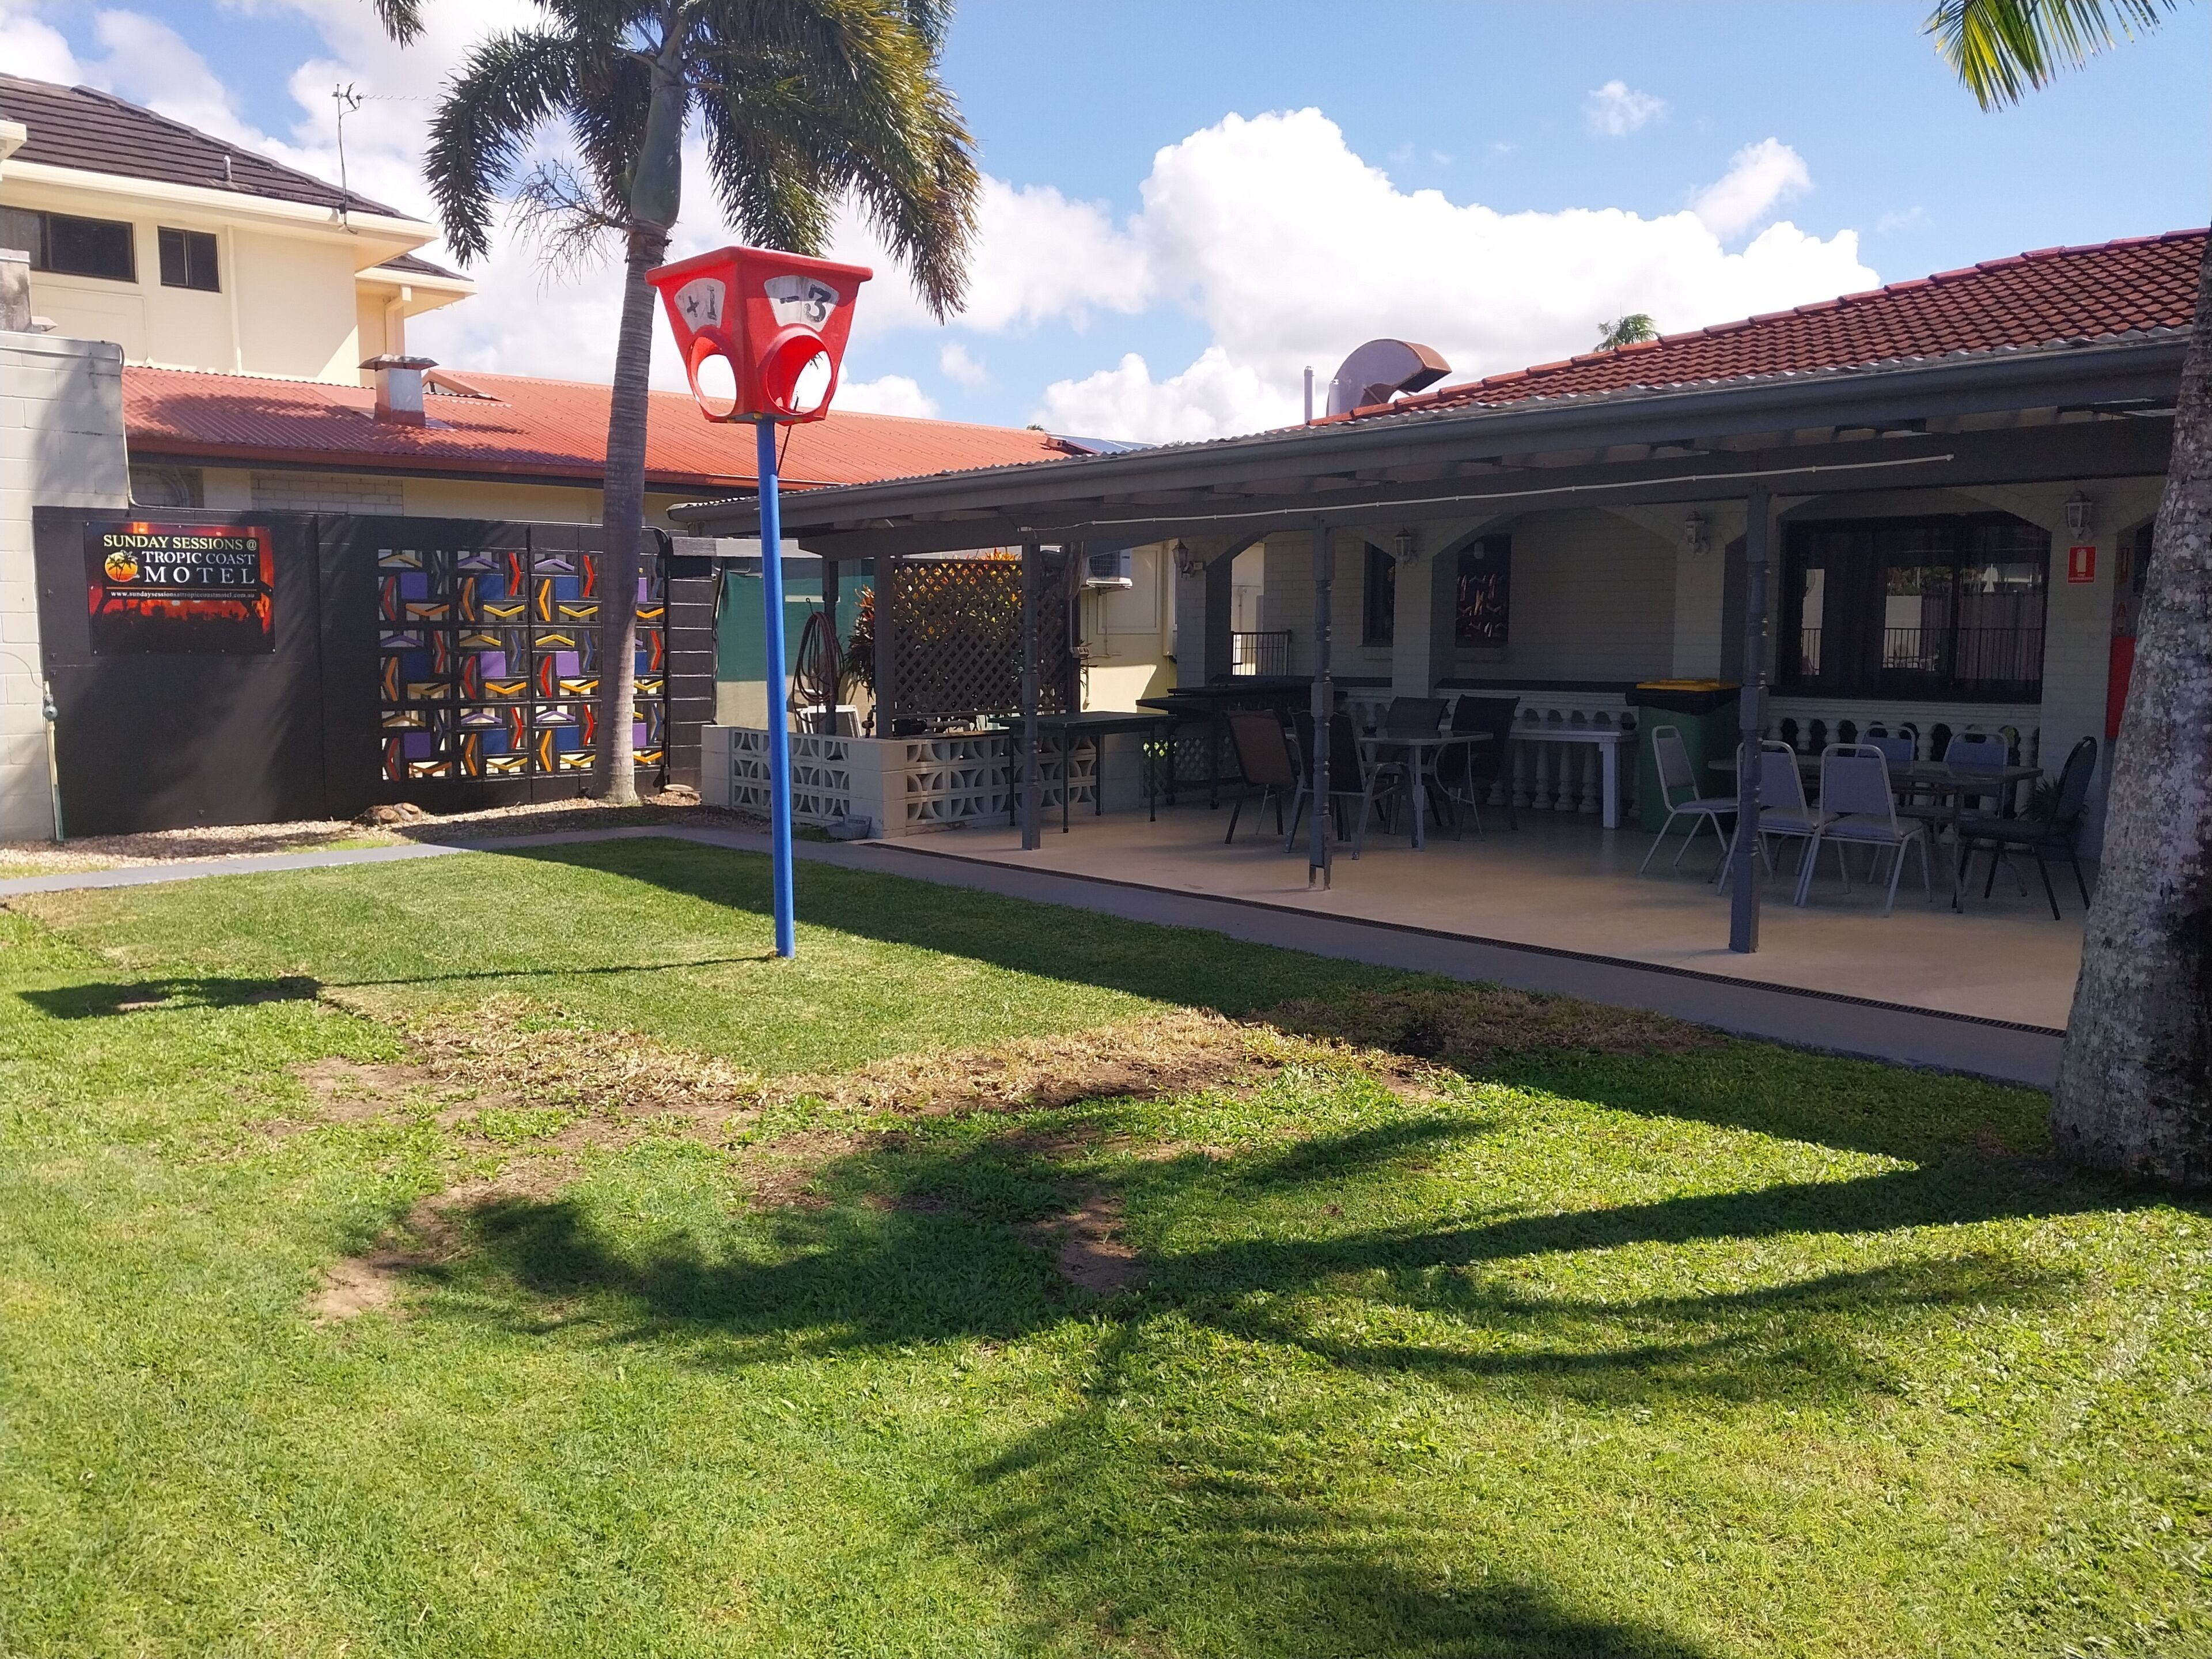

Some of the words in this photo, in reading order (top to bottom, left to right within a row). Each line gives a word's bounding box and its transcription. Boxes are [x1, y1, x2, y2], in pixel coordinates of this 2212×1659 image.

[103, 534, 169, 548] SUNDAY
[172, 537, 243, 550] SESSIONS
[246, 539, 257, 551] @
[142, 551, 202, 564] TROPIC
[206, 553, 255, 565] COAST
[145, 566, 255, 584] MOTEL
[111, 591, 255, 599] www.sundaysessionsattropiccoastmotel.com.au
